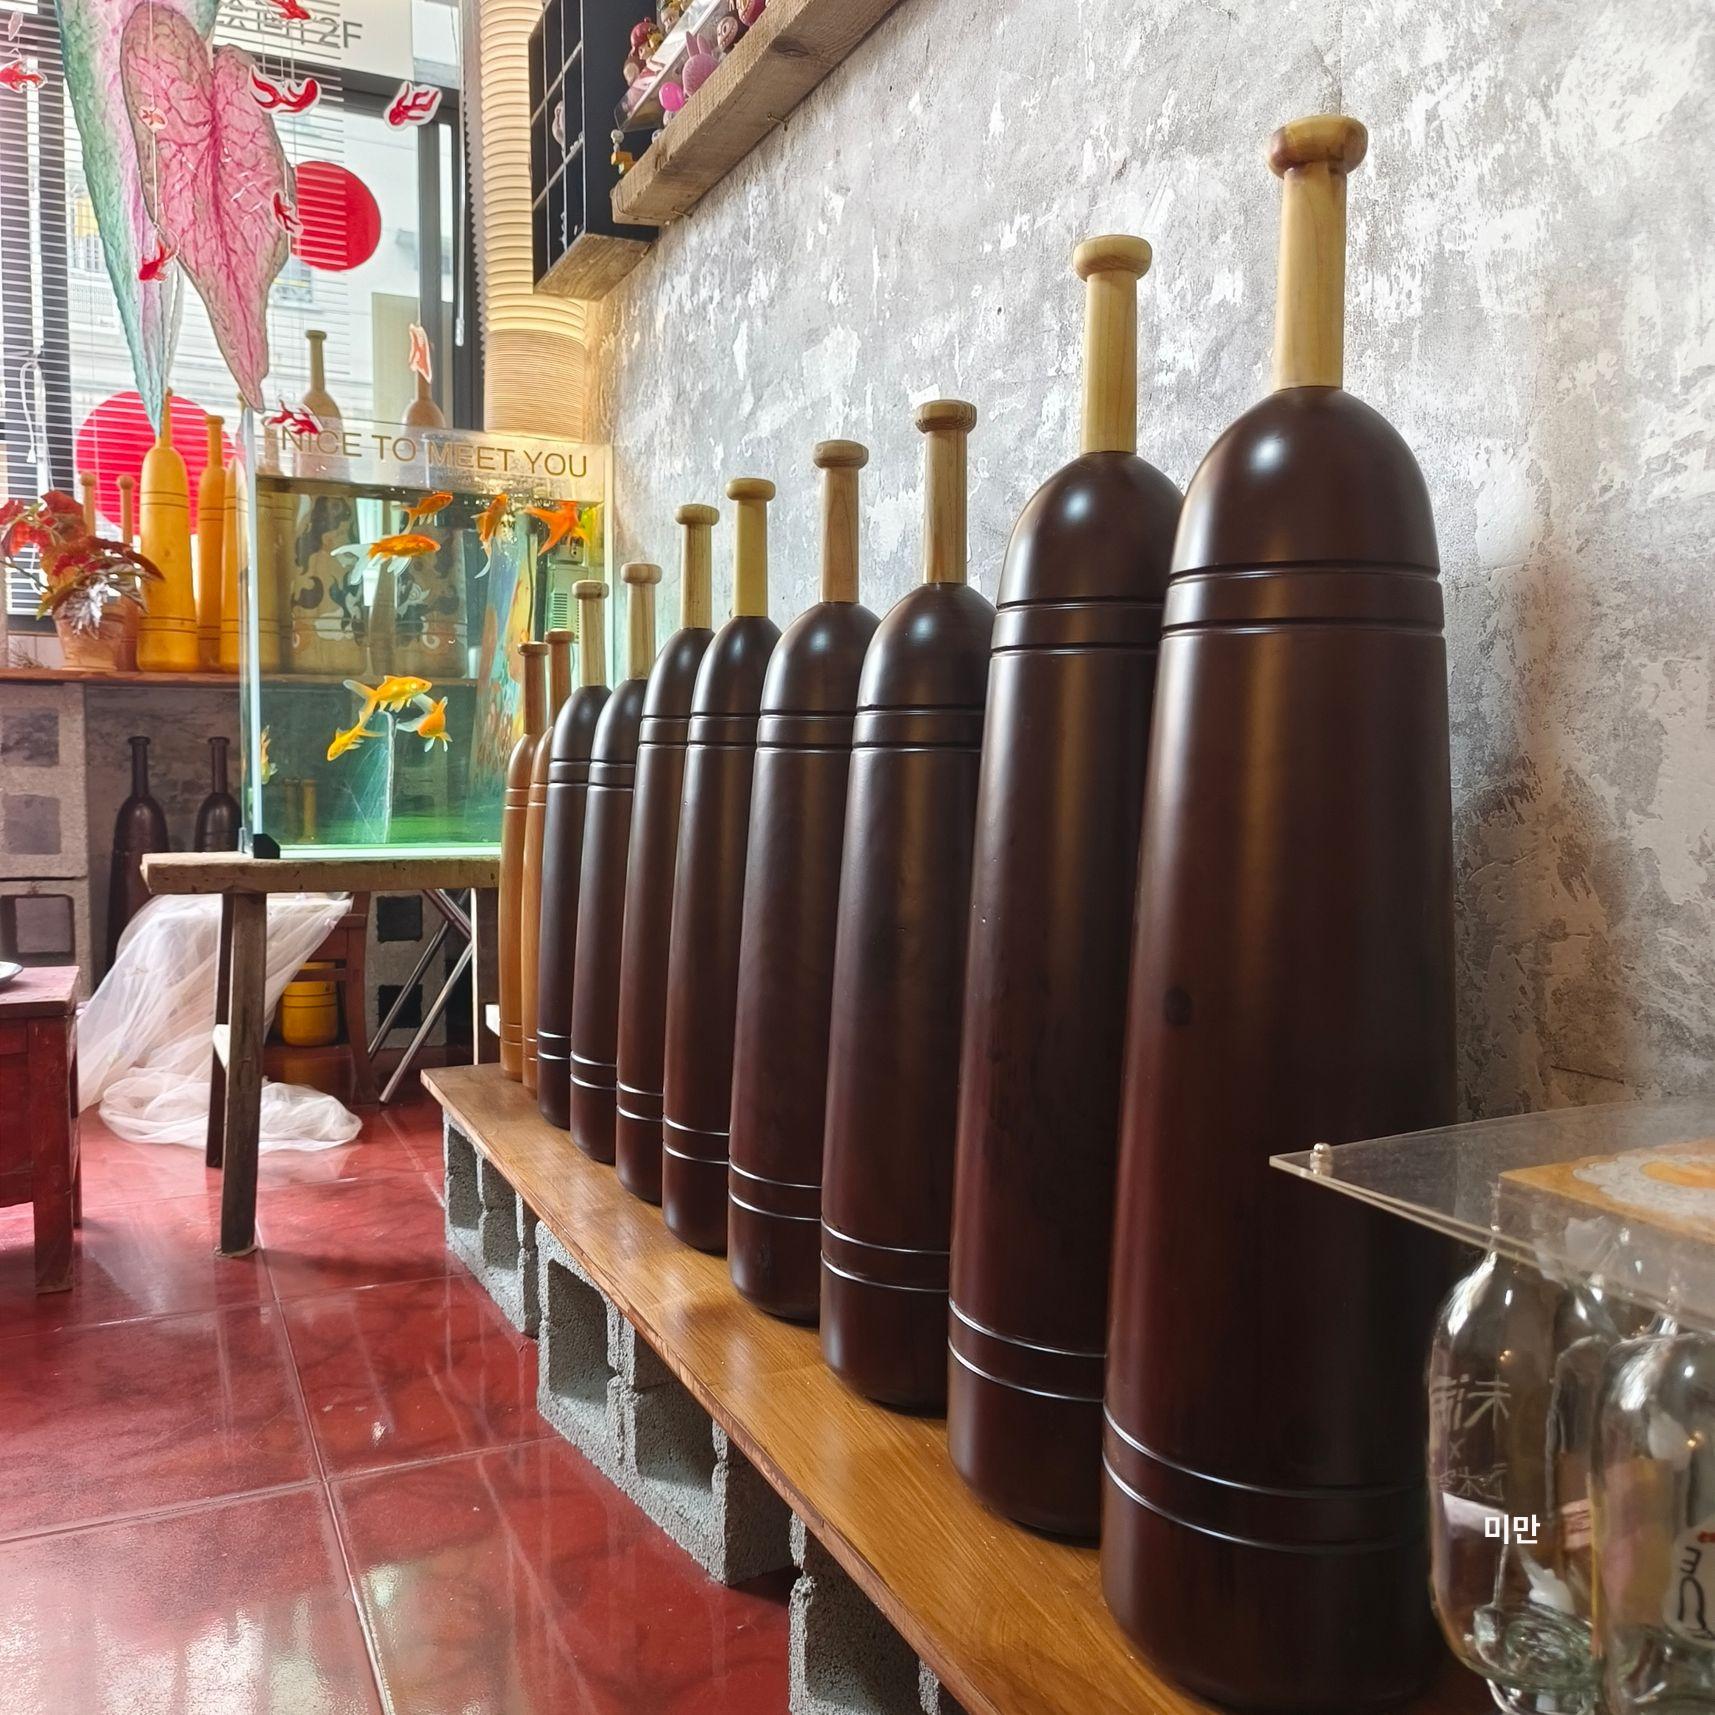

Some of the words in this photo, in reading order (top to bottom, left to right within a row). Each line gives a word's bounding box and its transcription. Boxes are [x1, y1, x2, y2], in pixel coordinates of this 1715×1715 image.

[281, 425, 362, 457] NICE
[371, 434, 416, 461] TO
[428, 443, 515, 472] MEET
[523, 450, 587, 478] YOU
